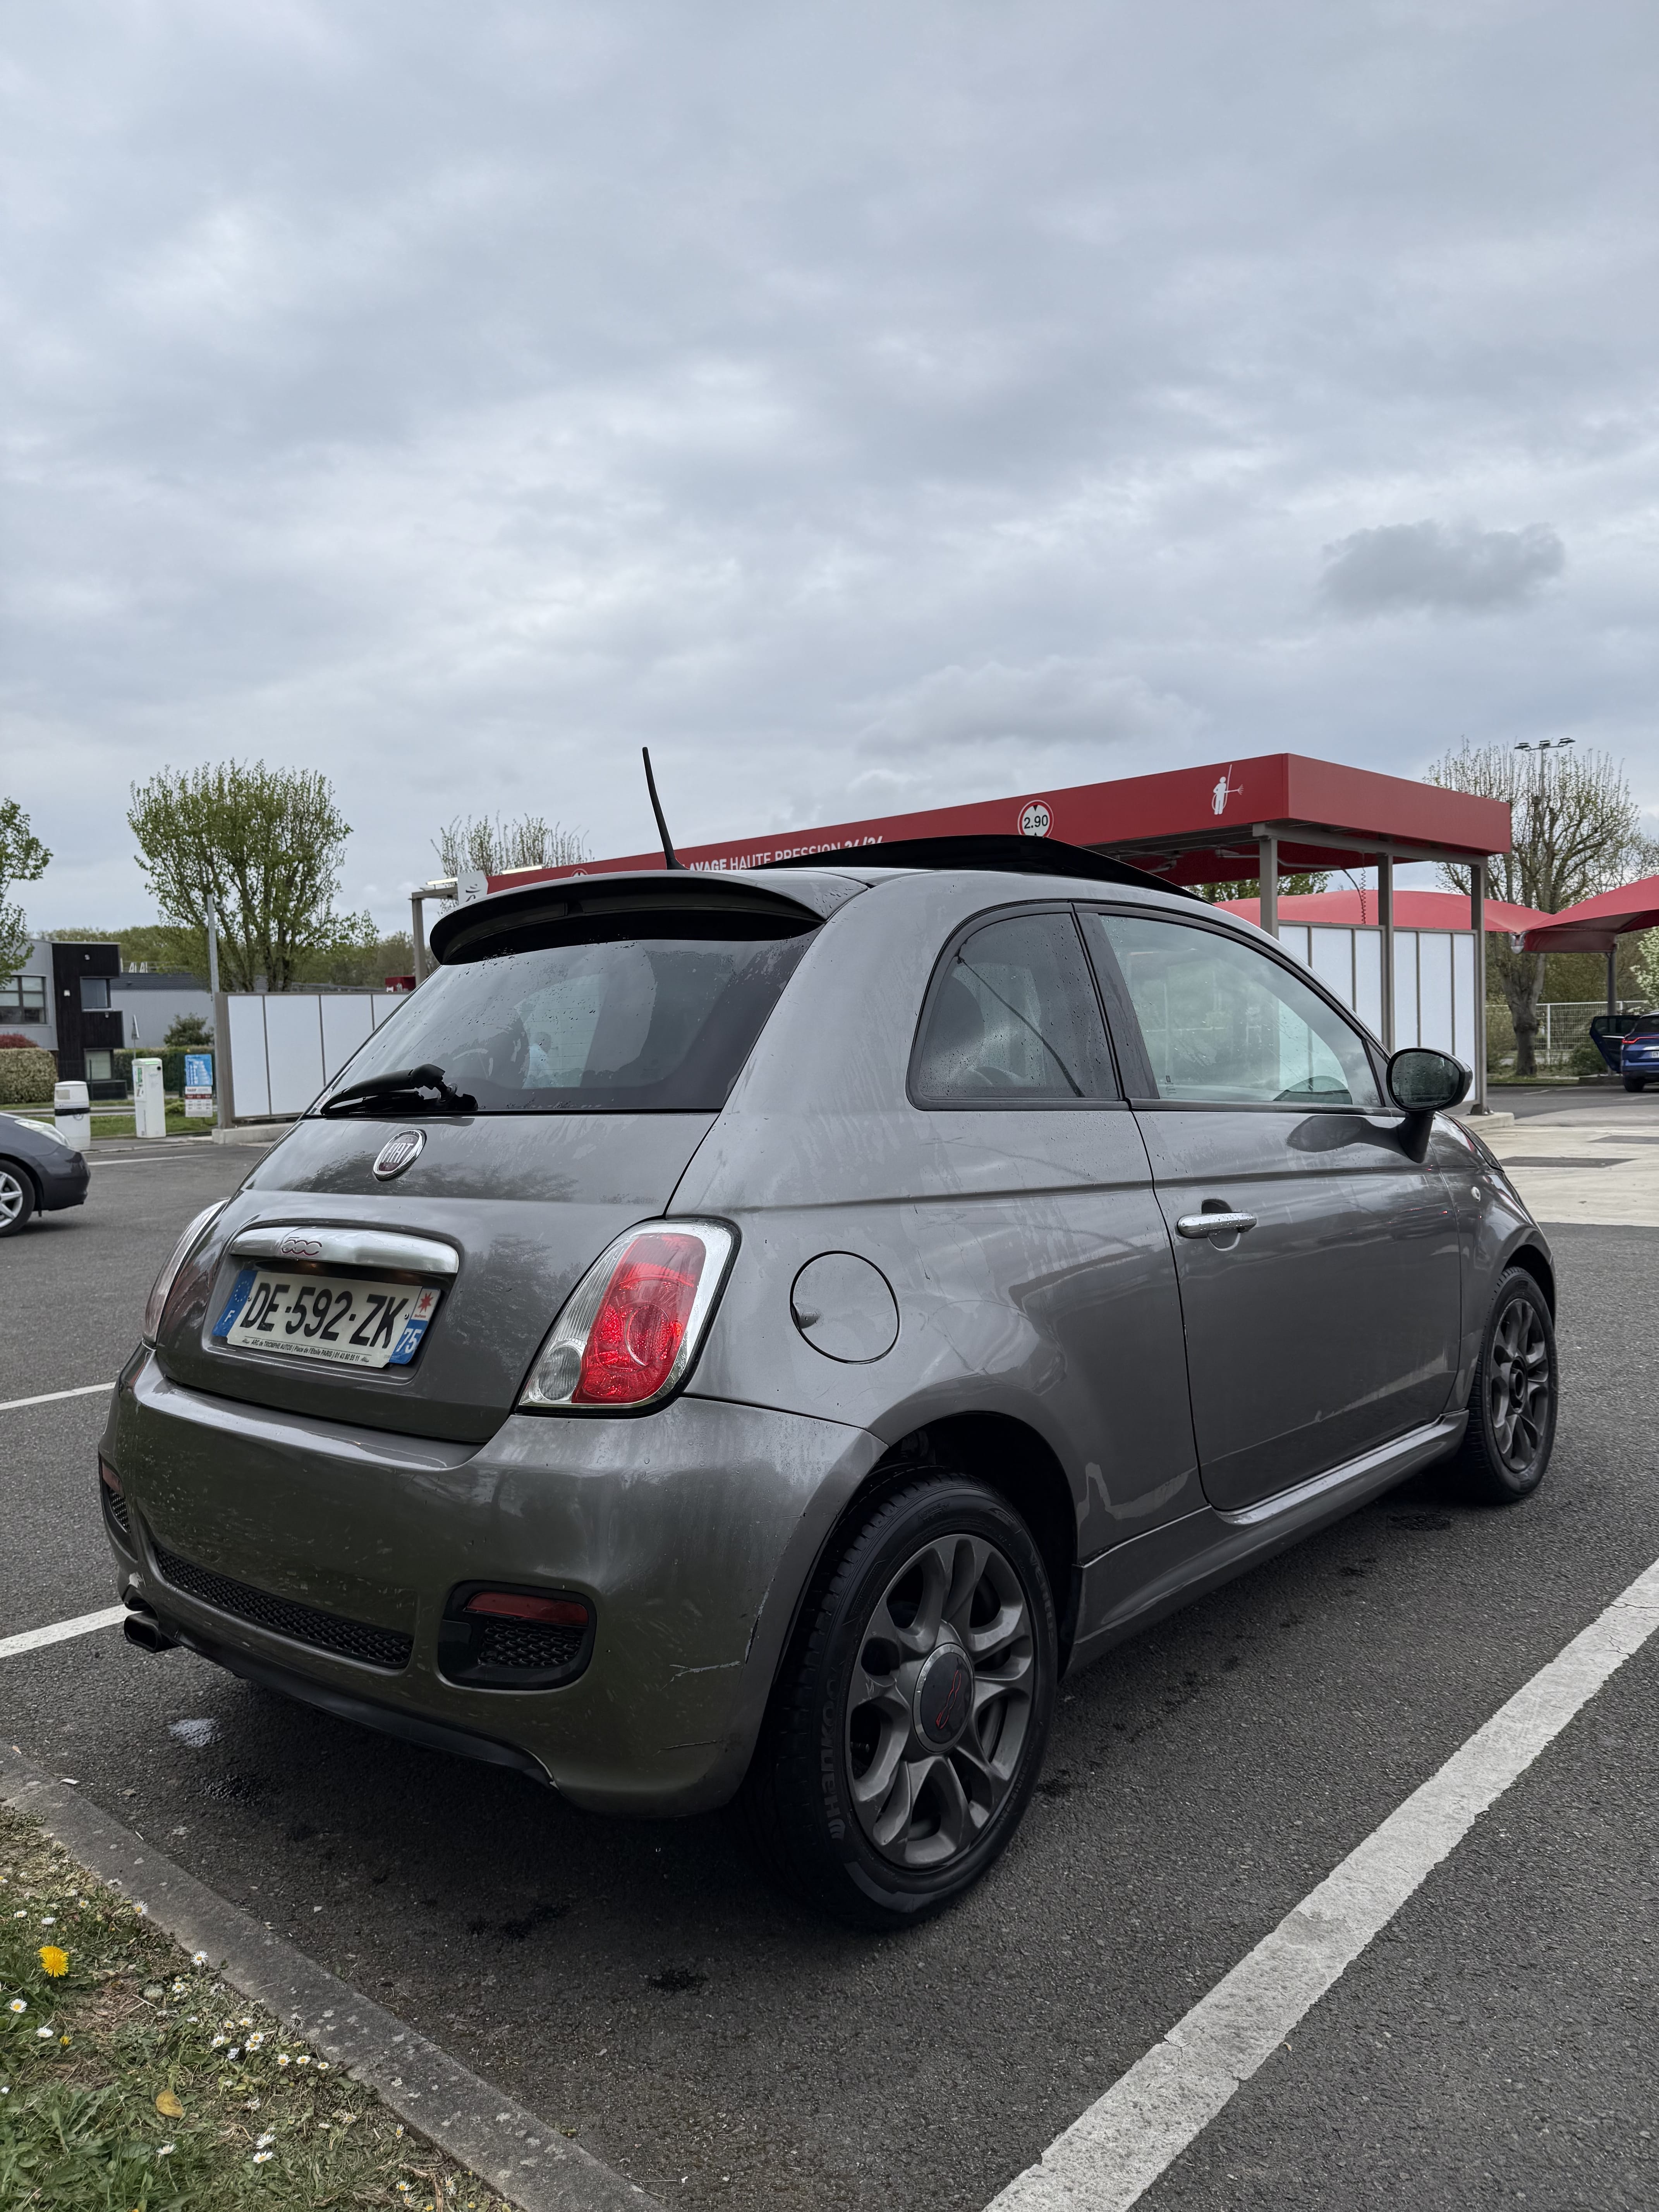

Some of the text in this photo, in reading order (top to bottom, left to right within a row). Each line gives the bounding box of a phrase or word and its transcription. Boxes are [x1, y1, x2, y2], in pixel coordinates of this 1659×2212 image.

[1024, 815, 1048, 829] 2.90
[683, 859, 727, 871] AVAGE
[730, 852, 771, 870] HAUTE
[382, 1142, 414, 1163] FIAT
[281, 1237, 322, 1255] 500
[224, 1310, 235, 1322] F
[396, 1328, 422, 1353] 75
